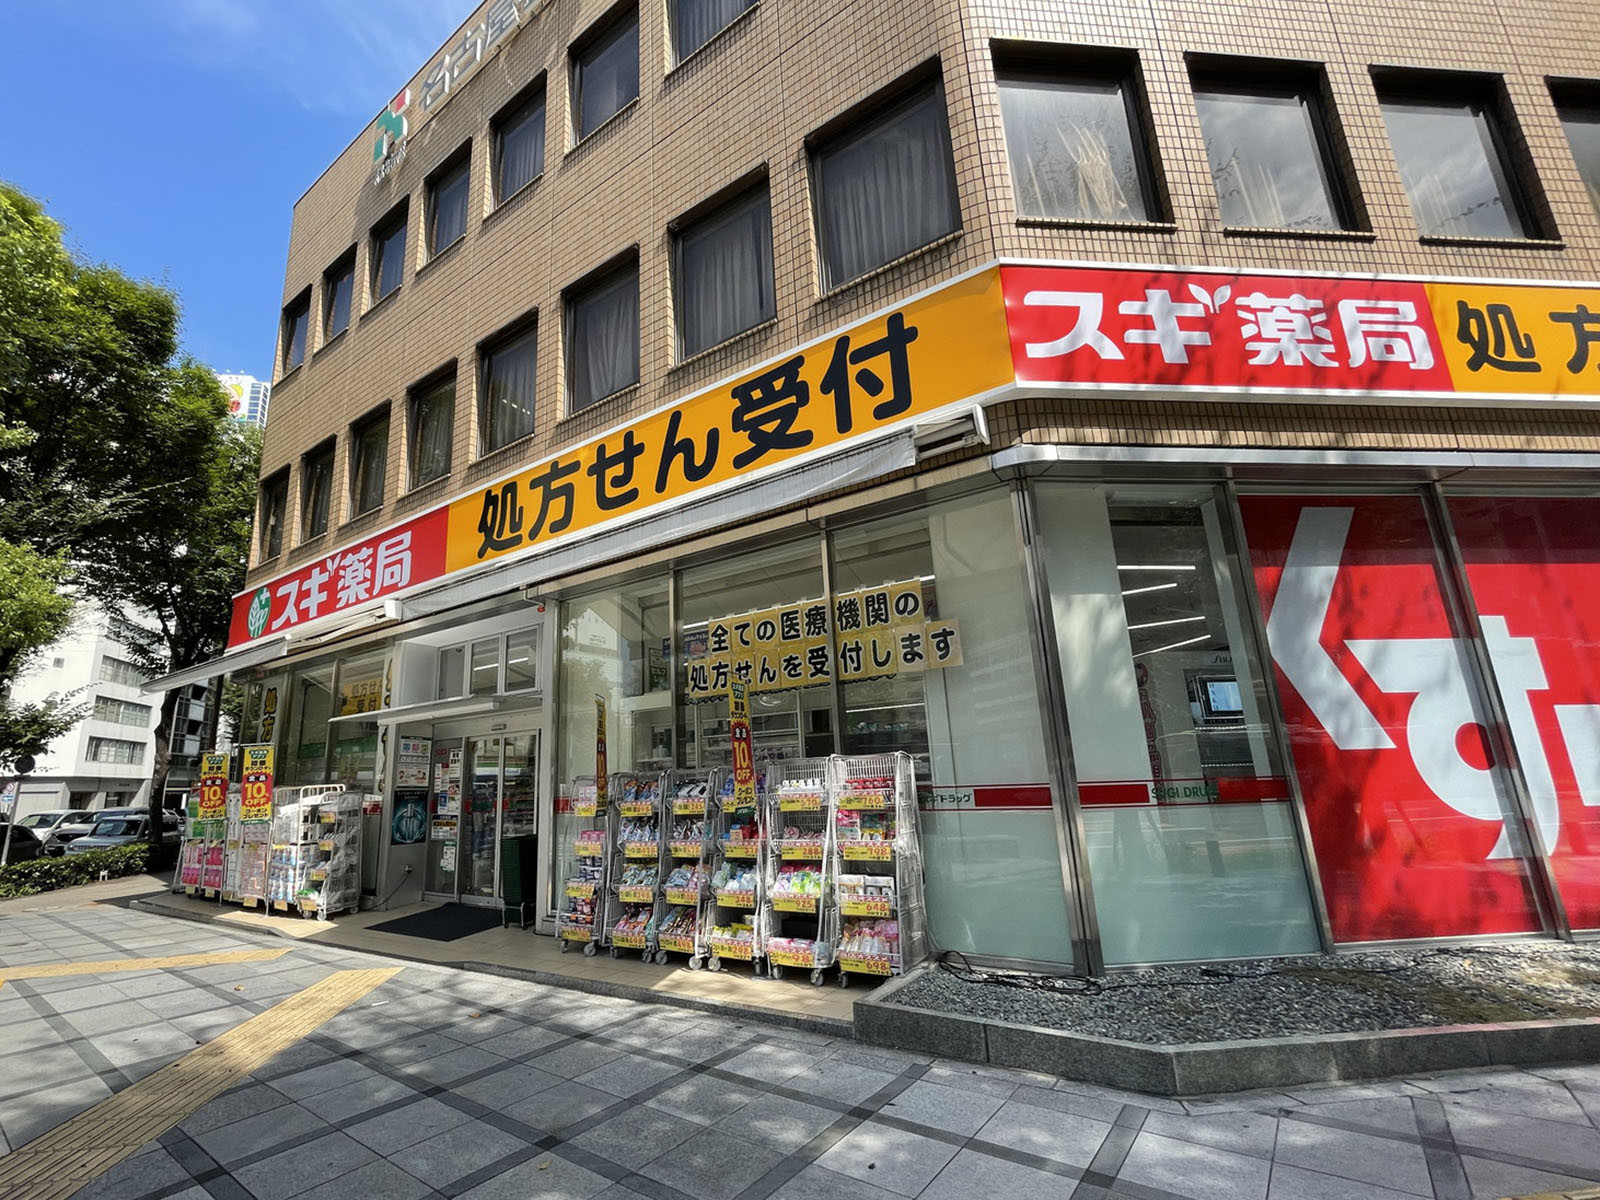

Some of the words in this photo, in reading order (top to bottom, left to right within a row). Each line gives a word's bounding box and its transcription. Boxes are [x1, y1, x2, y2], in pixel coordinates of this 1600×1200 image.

[419, 0, 536, 111] 名古屋
[1023, 284, 1434, 370] スギ薬局
[477, 312, 918, 559] 処方せん受付
[271, 530, 412, 631] スギ薬局
[710, 592, 920, 653] 全ての医療機関の
[690, 628, 955, 693] 処方せんを受付します
[1265, 506, 1600, 860] くす
[737, 769, 751, 780] OFF
